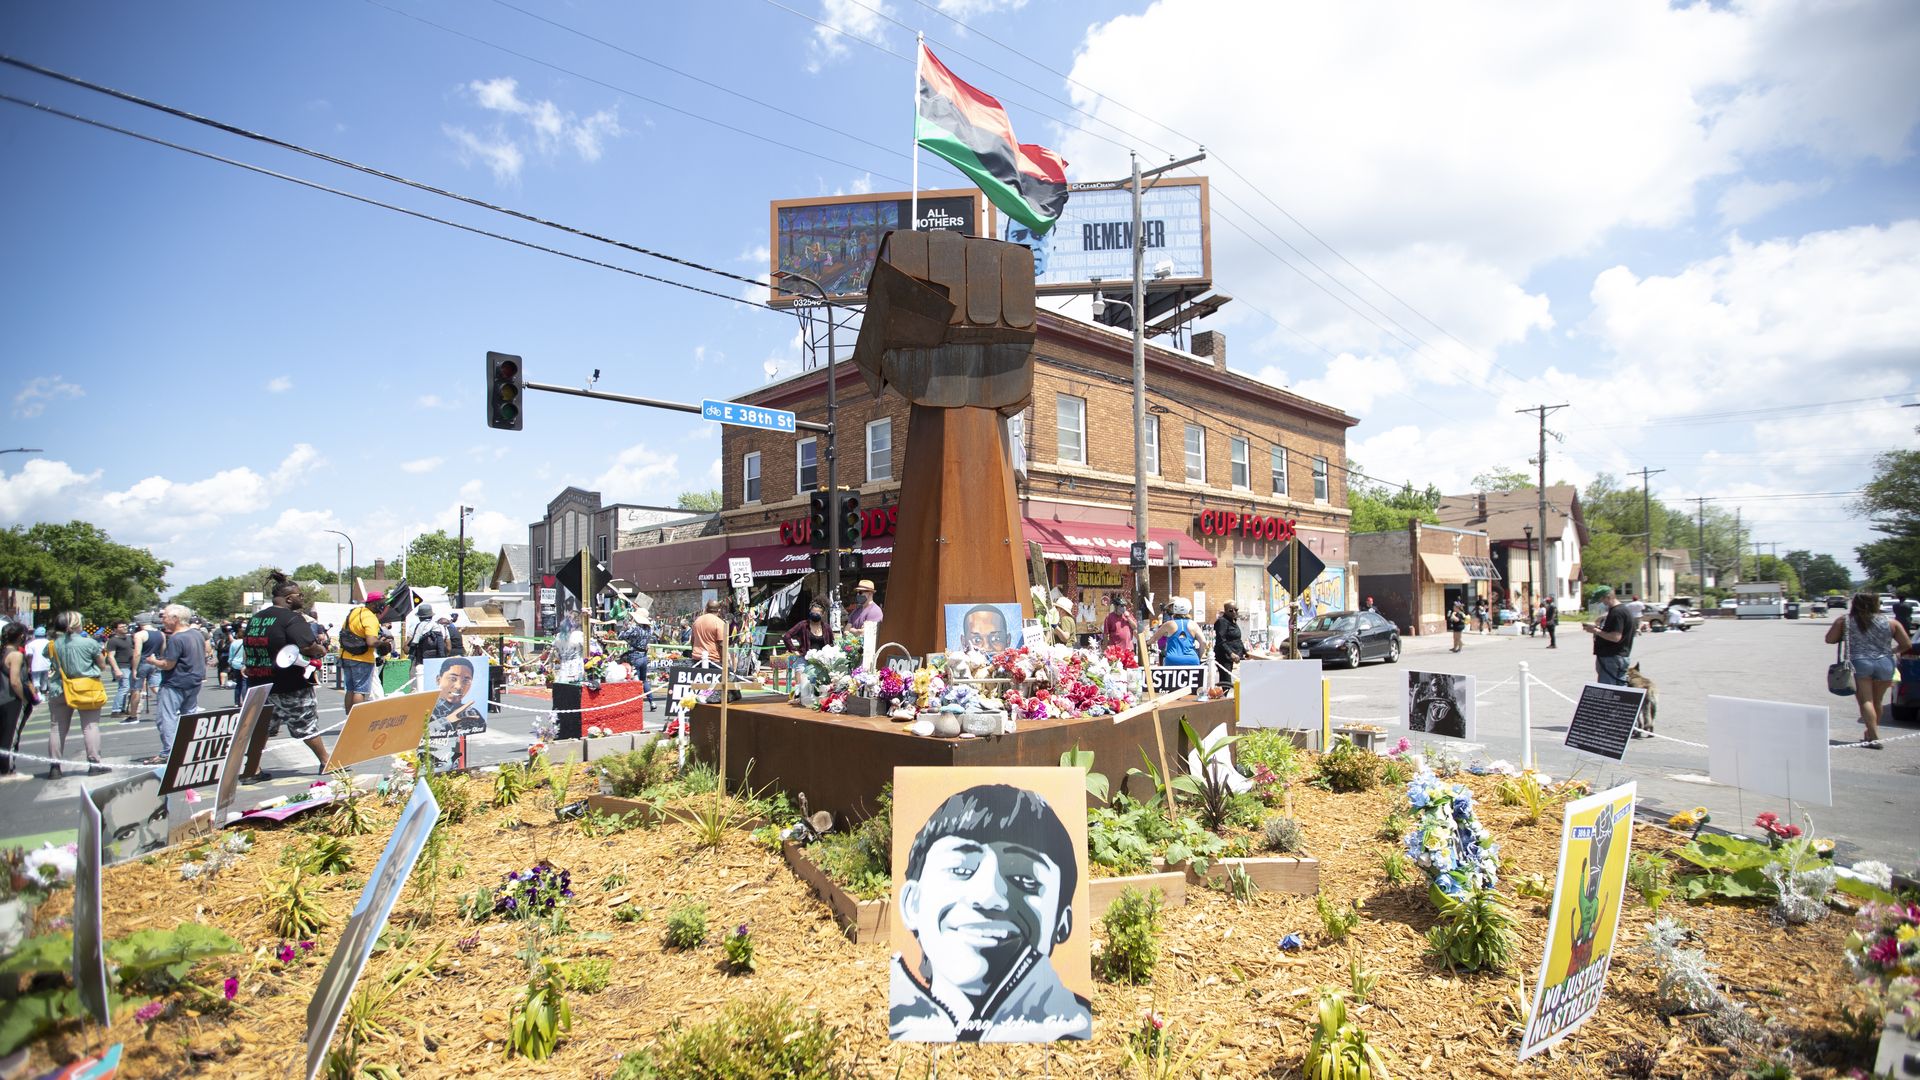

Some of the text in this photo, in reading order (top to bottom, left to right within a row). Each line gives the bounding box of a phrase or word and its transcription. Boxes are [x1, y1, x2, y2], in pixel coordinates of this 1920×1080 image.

[927, 208, 948, 218] ALL
[1083, 220, 1165, 251] REMEMER
[724, 406, 792, 428] E 38th St
[861, 505, 898, 538] ODS
[1200, 508, 1296, 542] CUP FOODS
[733, 573, 751, 583] 25
[262, 617, 277, 626] CAN
[660, 659, 674, 667] FOR
[677, 671, 722, 684] BLACK
[1142, 669, 1200, 688] USTICE
[193, 713, 241, 740] BLAC
[191, 737, 232, 762] LIVE
[173, 755, 248, 788] MATTR
[1542, 957, 1605, 1014] NO JUSTICE
[1530, 980, 1602, 1047] NO STREETS
